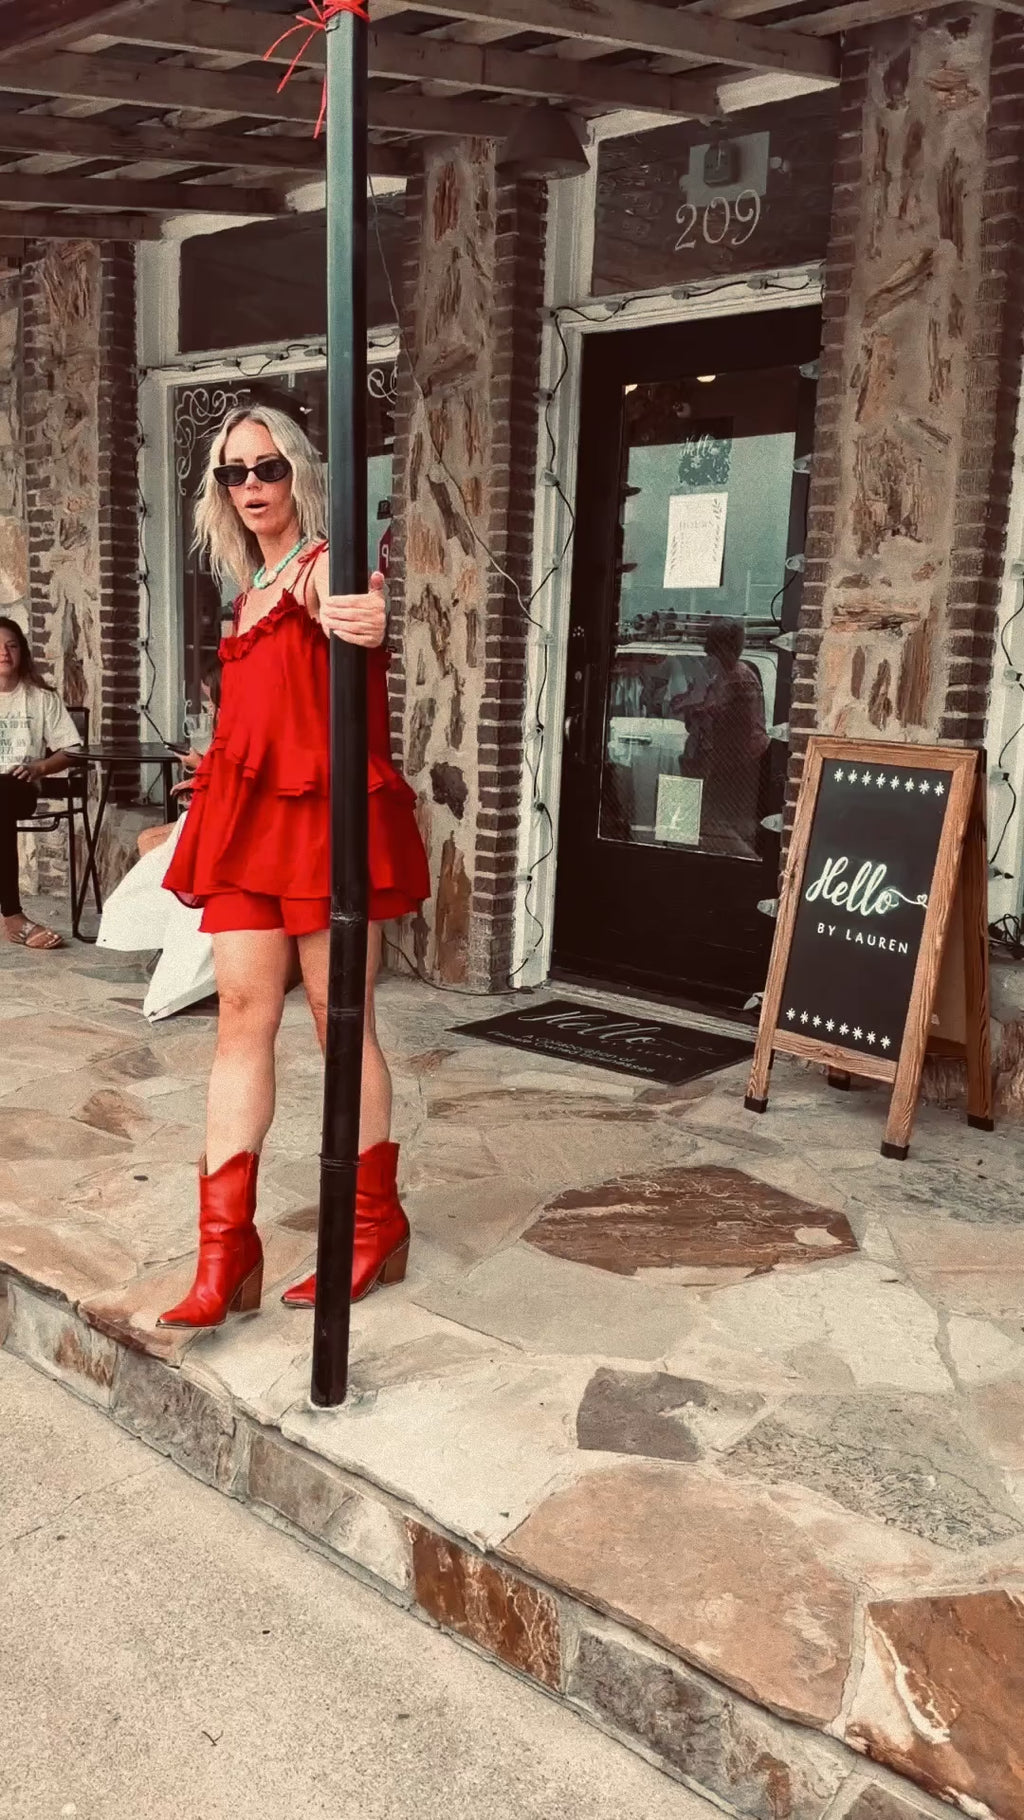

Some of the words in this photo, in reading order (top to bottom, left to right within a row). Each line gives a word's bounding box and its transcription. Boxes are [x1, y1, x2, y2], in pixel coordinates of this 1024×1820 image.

[675, 189, 761, 251] 209
[805, 856, 905, 916] Hello
[817, 922, 837, 937] BY
[846, 929, 909, 954] LAUREN
